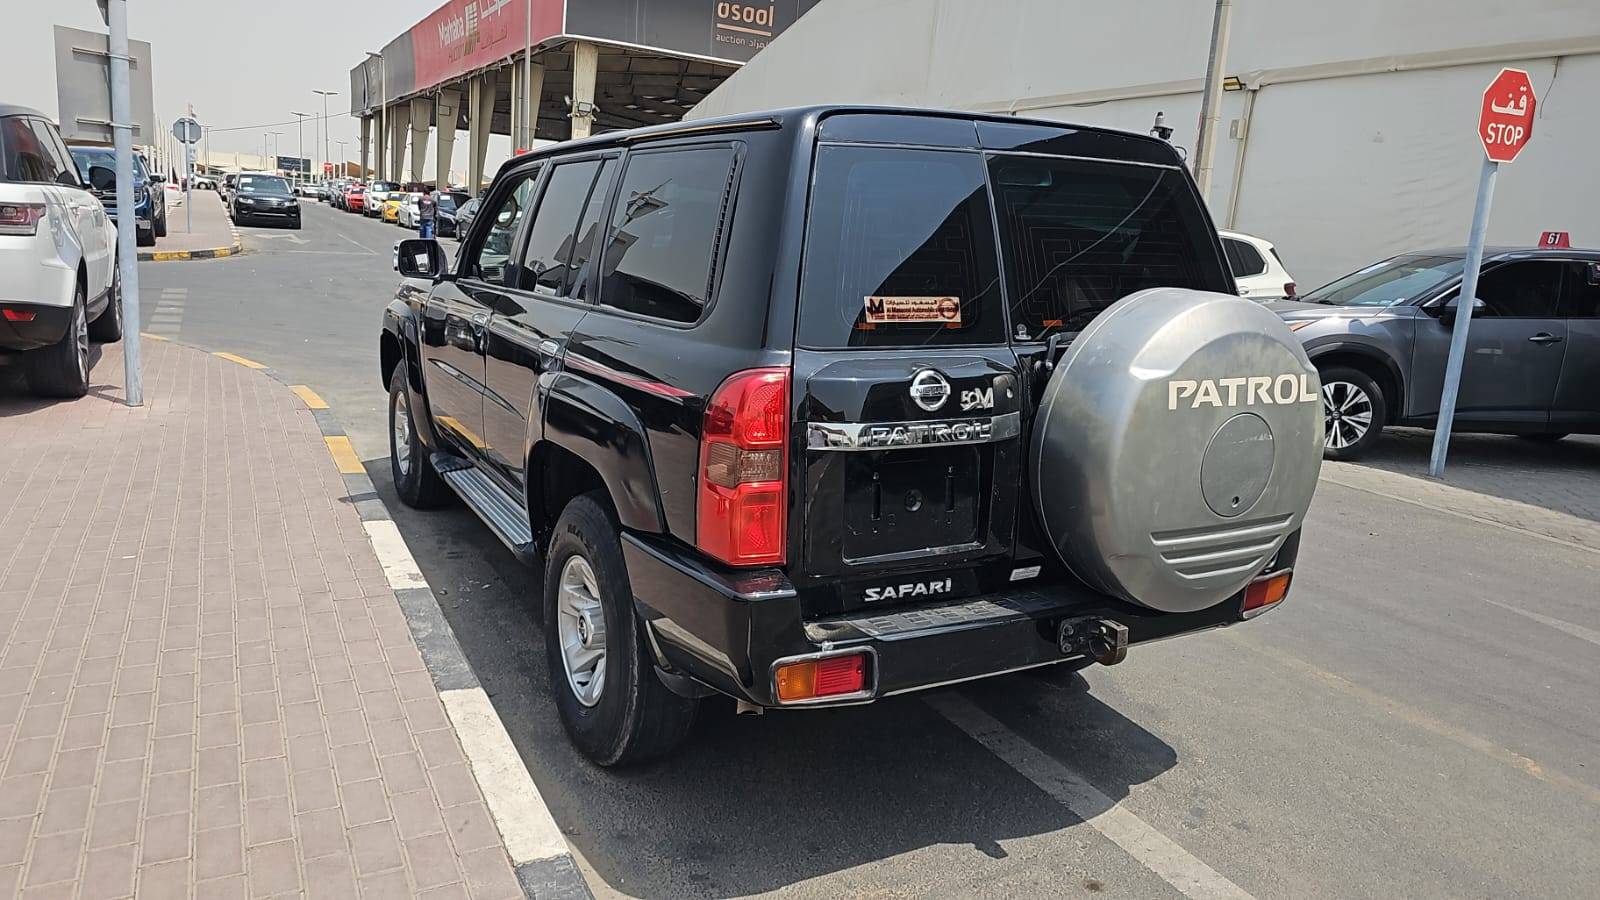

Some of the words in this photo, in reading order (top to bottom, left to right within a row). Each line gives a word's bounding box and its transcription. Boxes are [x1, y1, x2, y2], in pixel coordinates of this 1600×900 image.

[717, 2, 775, 27] osool
[715, 33, 746, 46] auction
[1491, 86, 1527, 116] قف
[1486, 123, 1523, 145] STOP
[1547, 232, 1561, 245] 61
[1168, 374, 1318, 411] PATROL
[870, 422, 992, 447] PATROL
[864, 578, 952, 601] SAFARI
